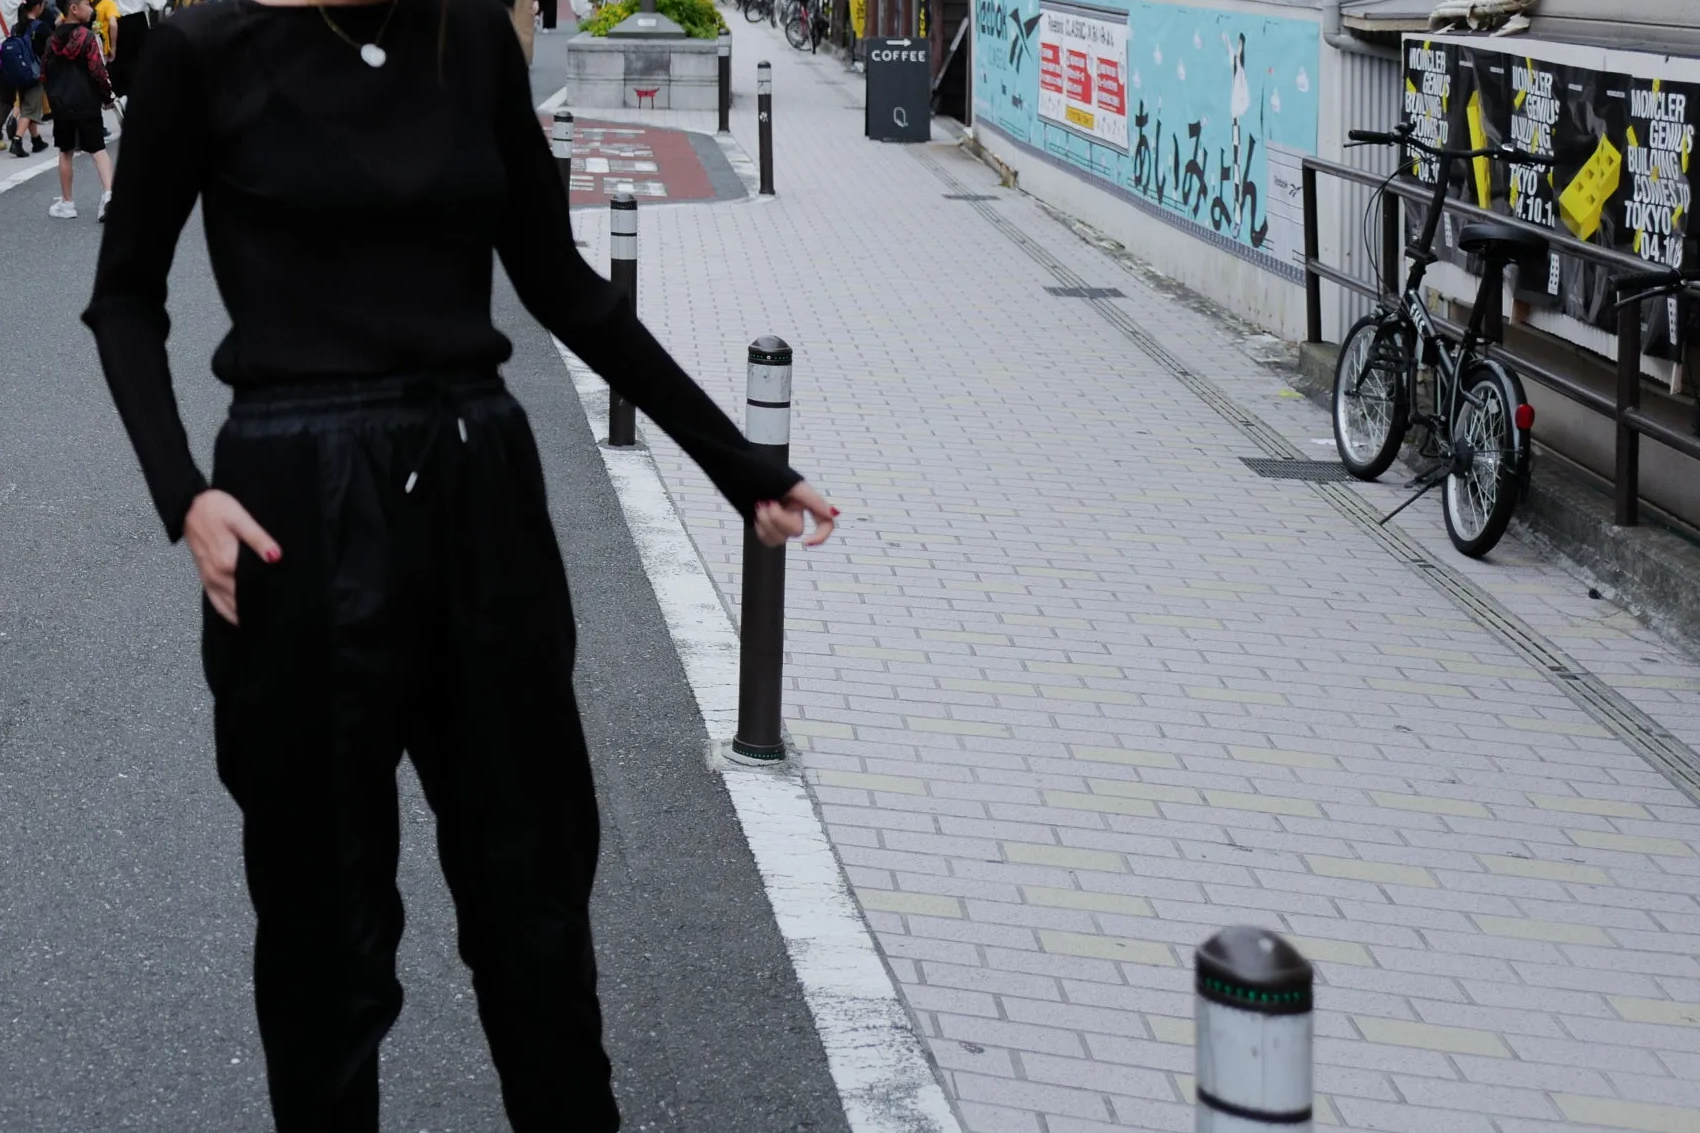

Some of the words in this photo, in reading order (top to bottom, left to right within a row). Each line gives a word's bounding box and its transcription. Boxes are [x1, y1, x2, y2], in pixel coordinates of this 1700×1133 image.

[871, 50, 926, 62] COFFEE
[1631, 89, 1686, 123] MONCLER
[1649, 119, 1694, 154] GENIUS
[1133, 98, 1269, 249] あいみょん
[1628, 145, 1679, 181] BUILDING
[1633, 173, 1678, 208] COMES
[1676, 182, 1691, 214] TO
[1624, 199, 1672, 236] TOKYO
